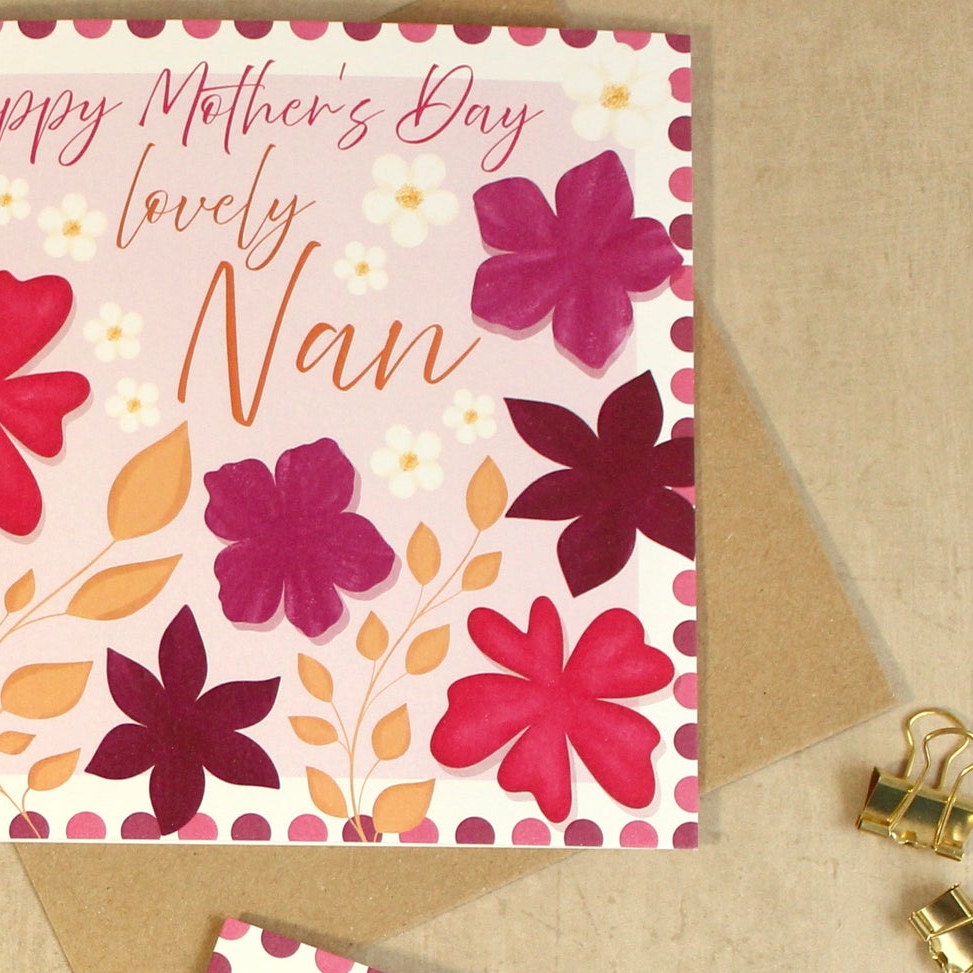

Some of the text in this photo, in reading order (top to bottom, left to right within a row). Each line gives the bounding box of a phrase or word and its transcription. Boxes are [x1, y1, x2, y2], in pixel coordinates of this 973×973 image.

[139, 59, 384, 154] Mother's
[394, 64, 543, 172] Day
[116, 143, 316, 271] lovely
[177, 241, 481, 427] Nan
